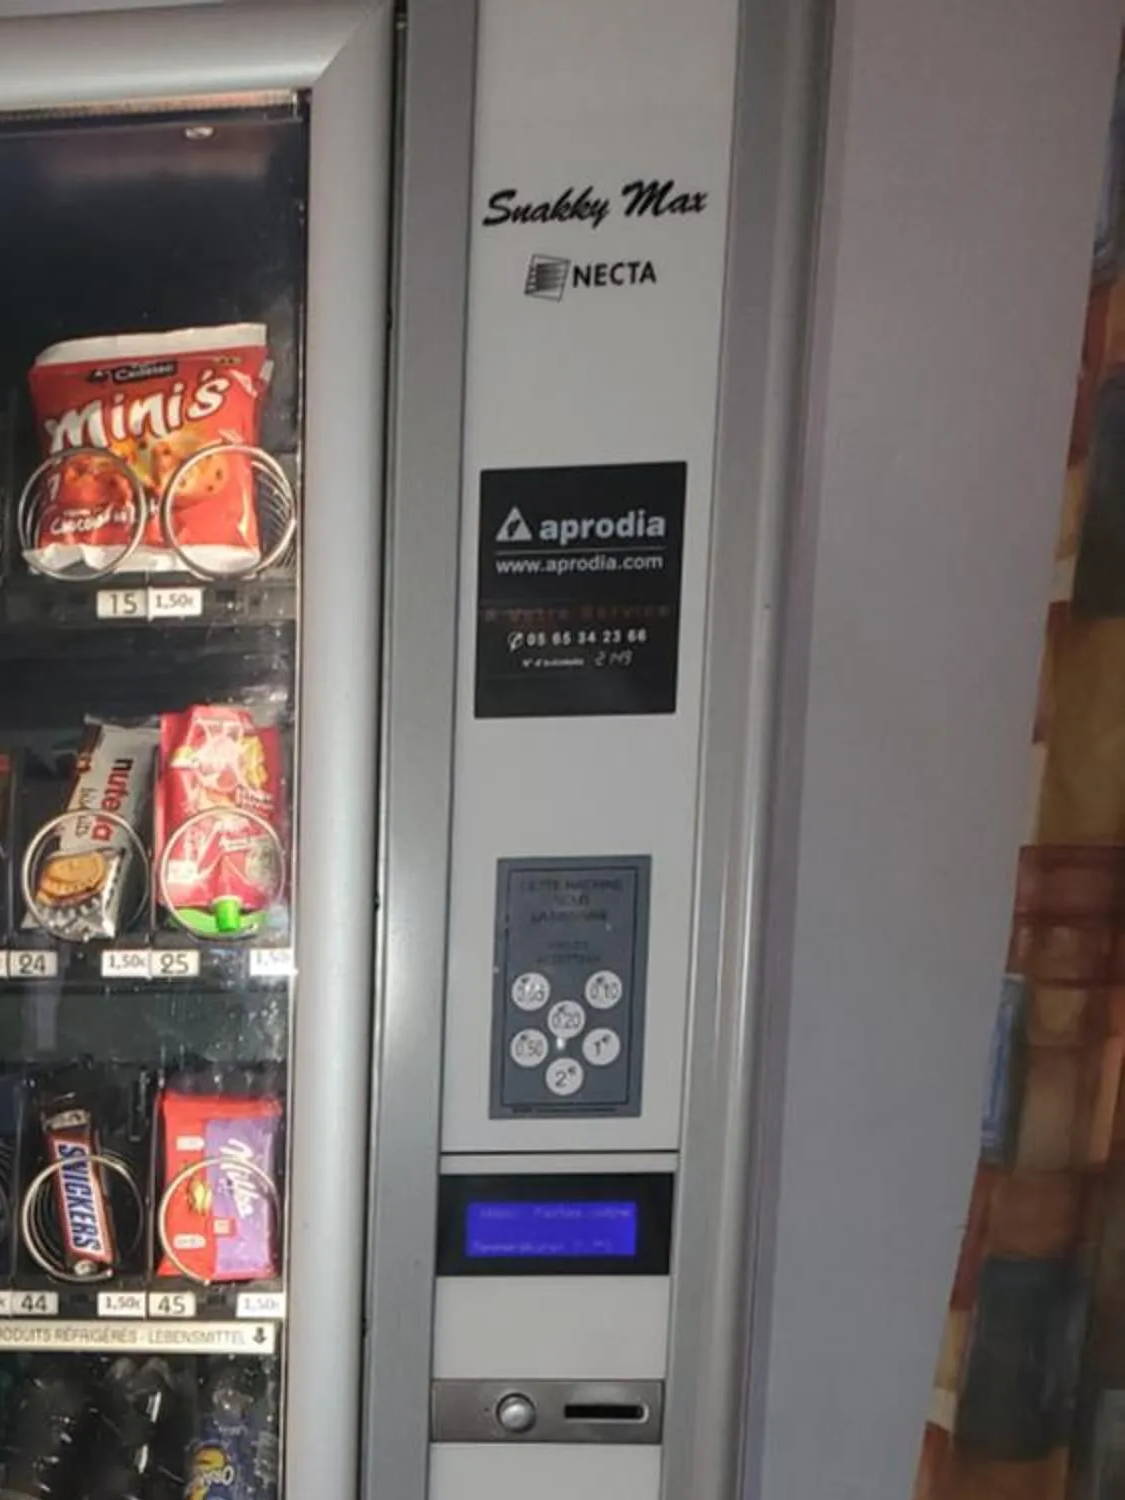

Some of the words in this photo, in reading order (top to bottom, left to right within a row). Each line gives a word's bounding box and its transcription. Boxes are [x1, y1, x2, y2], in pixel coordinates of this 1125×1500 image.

[482, 186, 610, 229] Snakky
[621, 180, 708, 217] Max
[572, 261, 656, 288] NECTA
[539, 509, 666, 545] aprodia
[496, 555, 663, 576] www.aprodia.com
[110, 593, 138, 614] 15
[18, 953, 47, 974] 24
[160, 953, 190, 975] 25
[58, 1144, 100, 1252] SNICKERS
[20, 1293, 47, 1312] 44
[157, 1295, 185, 1315] 45
